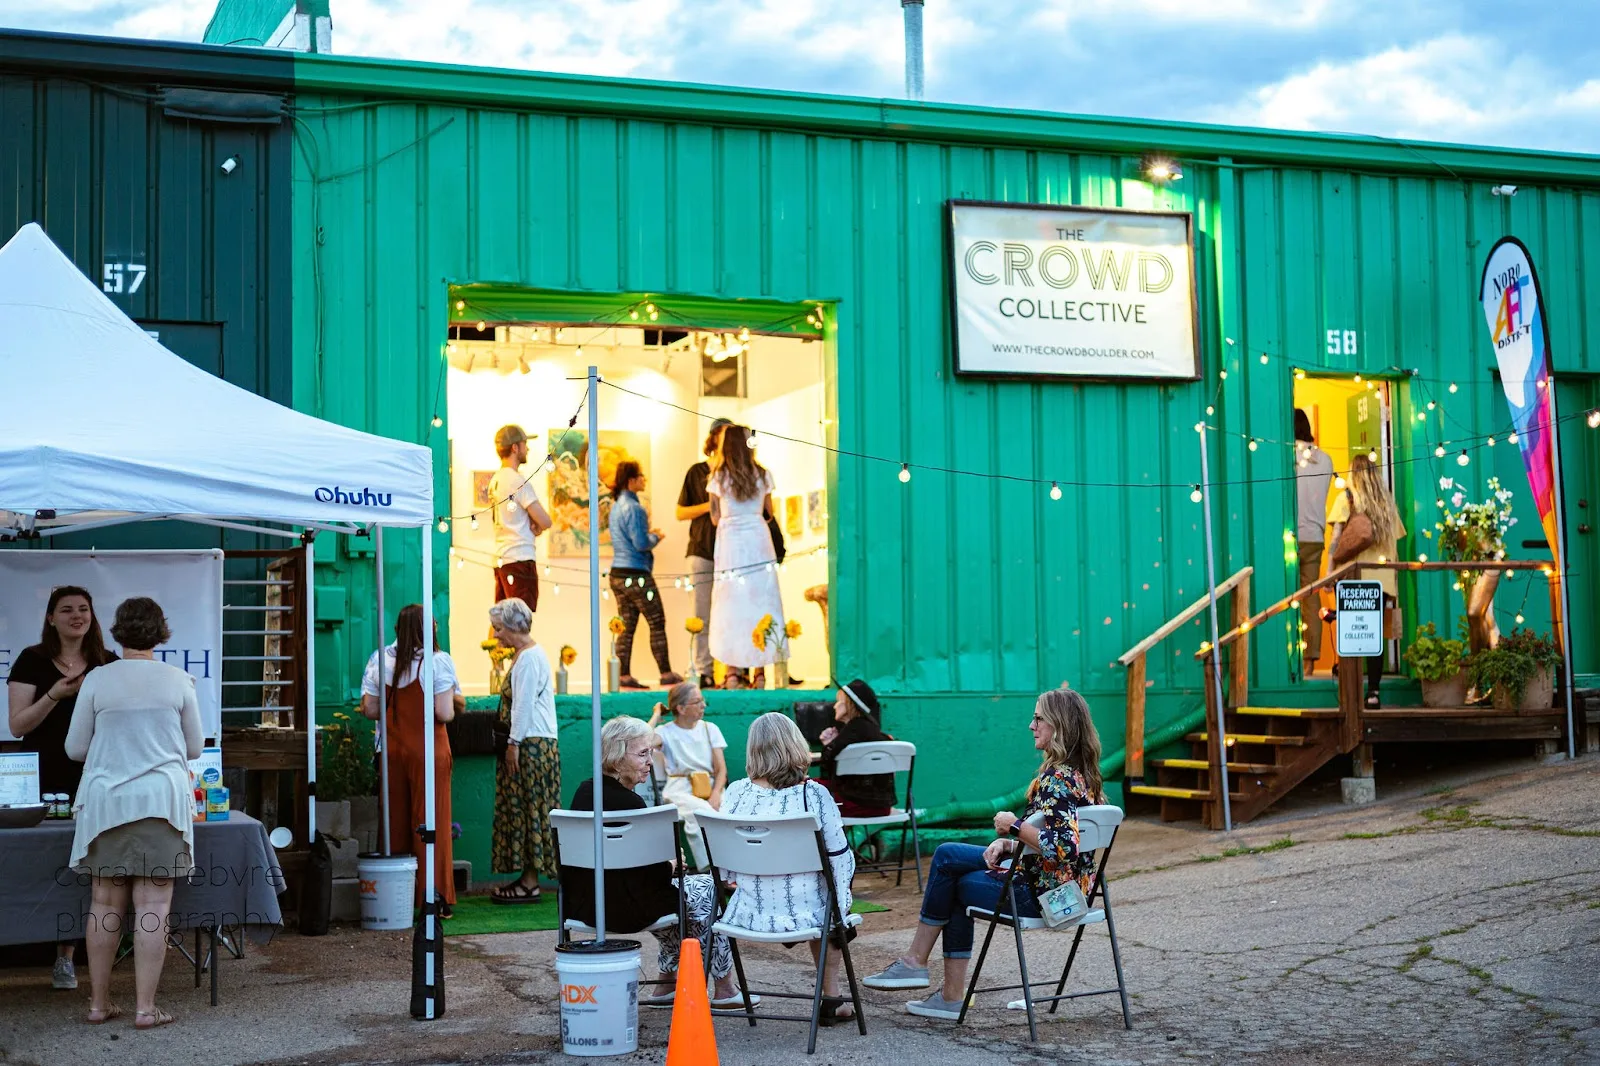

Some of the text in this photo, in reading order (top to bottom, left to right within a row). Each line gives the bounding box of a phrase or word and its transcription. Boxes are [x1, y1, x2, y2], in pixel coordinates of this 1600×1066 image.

[1056, 228, 1085, 241] THE
[965, 241, 1174, 294] CROWD
[103, 263, 147, 294] 57
[999, 298, 1147, 324] COLLECTIVE
[992, 344, 1155, 360] WWW.THECROWDBOULDER.COM
[1326, 329, 1357, 355] 58
[314, 485, 392, 507] Ohuhu
[1340, 588, 1380, 599] RESERVED
[1343, 600, 1376, 610] PARKING
[562, 1018, 569, 1036] 5
